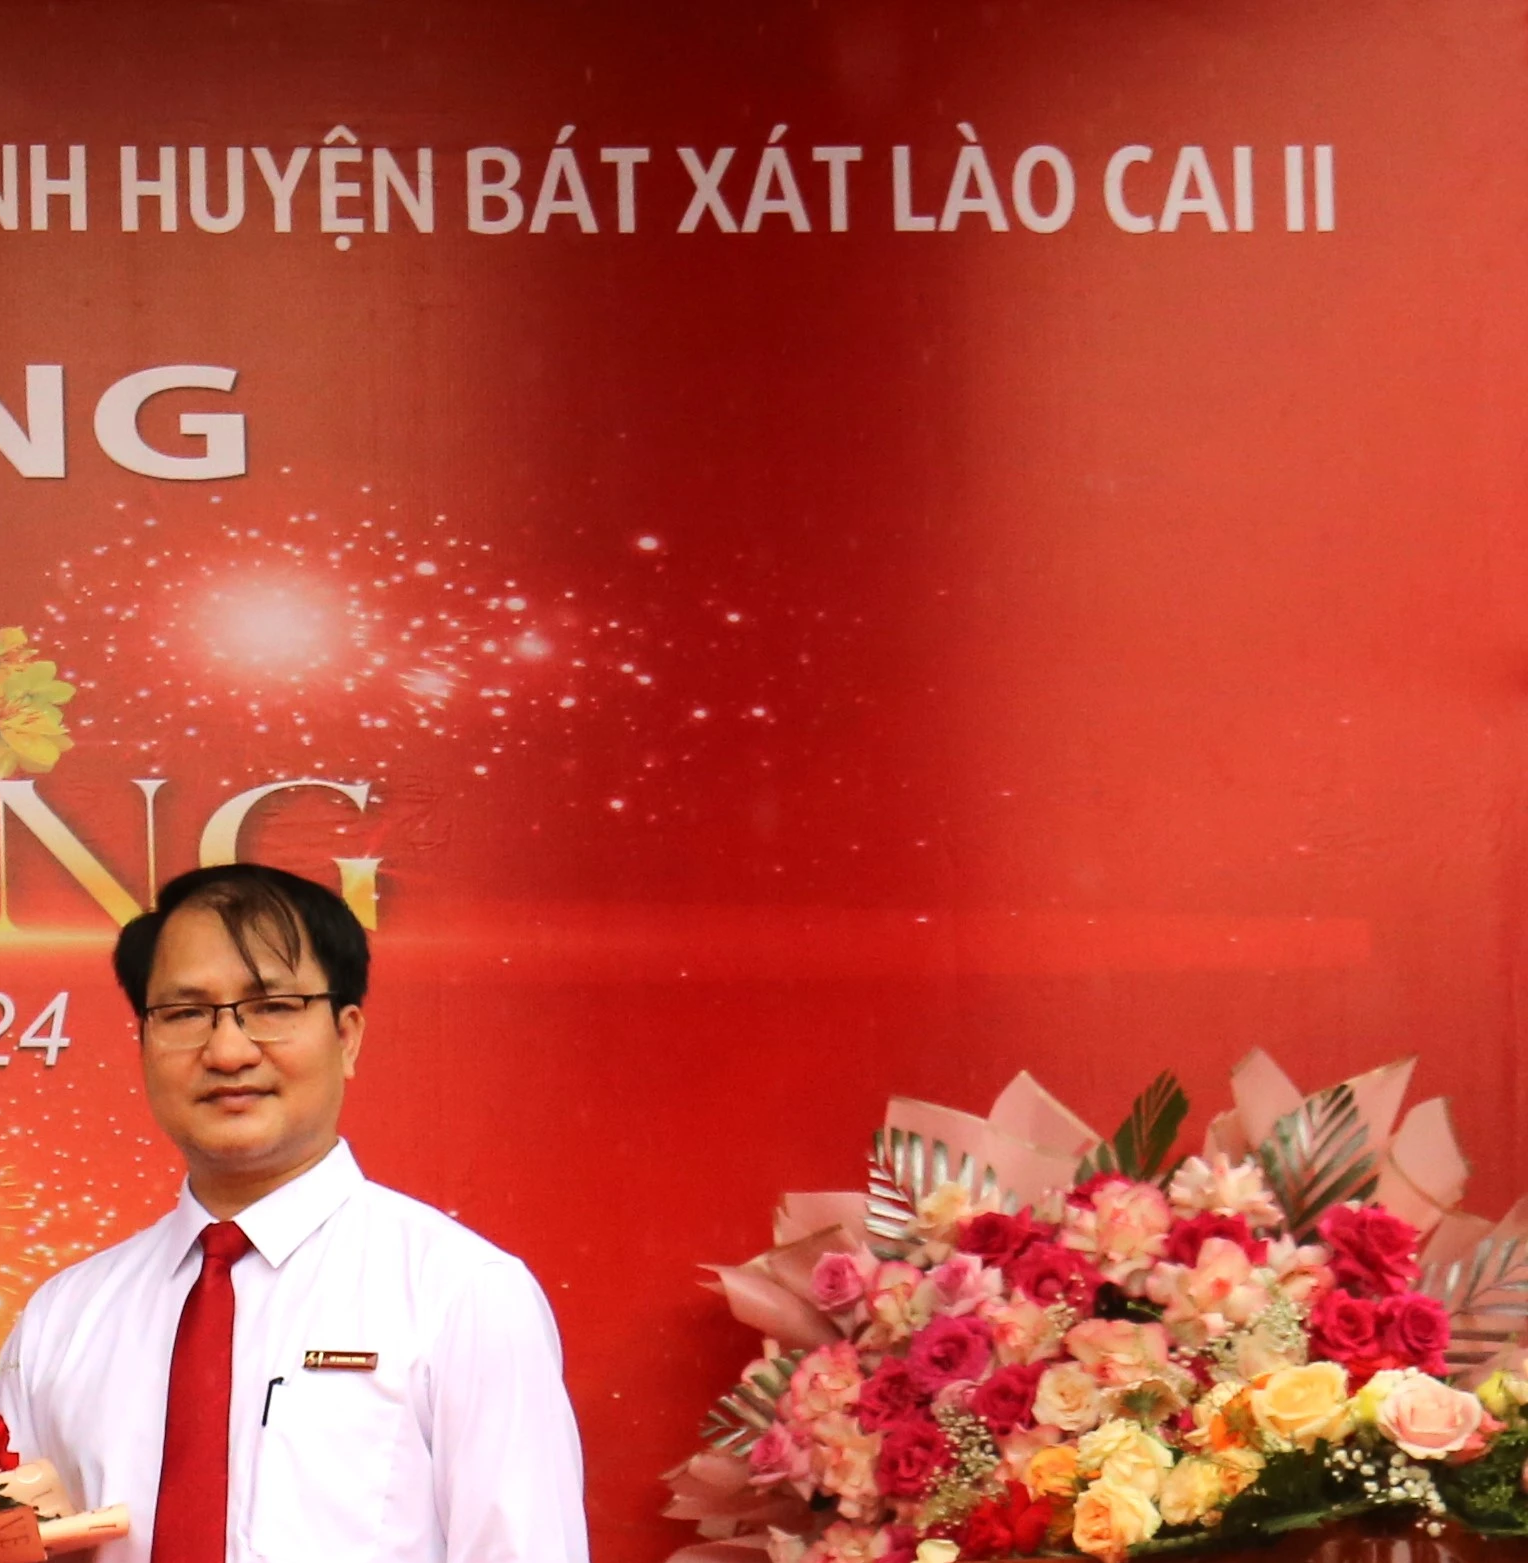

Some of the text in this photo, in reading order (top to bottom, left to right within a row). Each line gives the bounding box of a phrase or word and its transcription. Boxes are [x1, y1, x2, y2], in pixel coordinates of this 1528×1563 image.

[120, 124, 435, 252] HUYỆN
[465, 123, 650, 235] BÁT
[676, 123, 863, 234] XÁT
[891, 122, 1076, 233] LÀO
[1102, 144, 1253, 234] CAI
[1284, 144, 1335, 233] II
